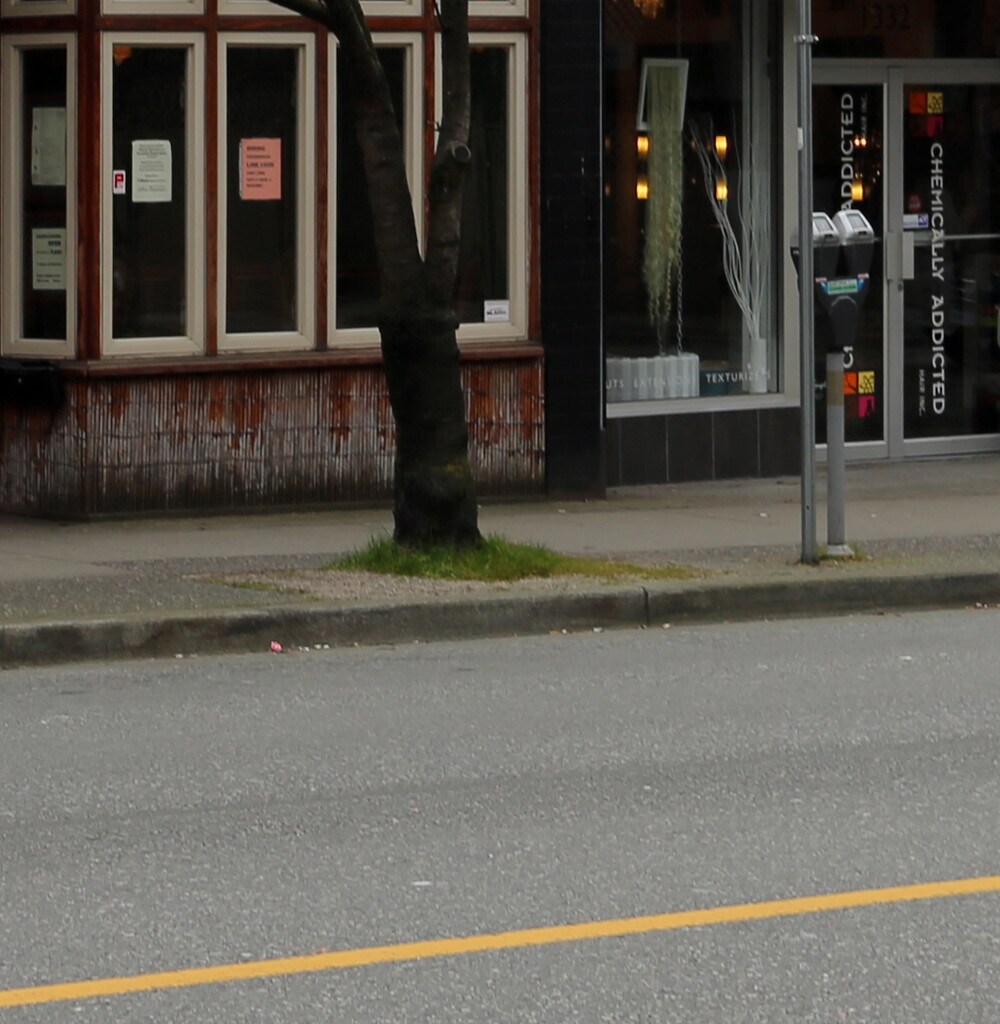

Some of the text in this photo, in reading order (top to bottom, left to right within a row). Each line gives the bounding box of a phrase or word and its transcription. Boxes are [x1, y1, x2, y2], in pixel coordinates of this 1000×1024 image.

[841, 93, 854, 211] ADDICTED
[930, 143, 945, 414] CHEMICALLY ADDICTED
[606, 379, 625, 389] UTS
